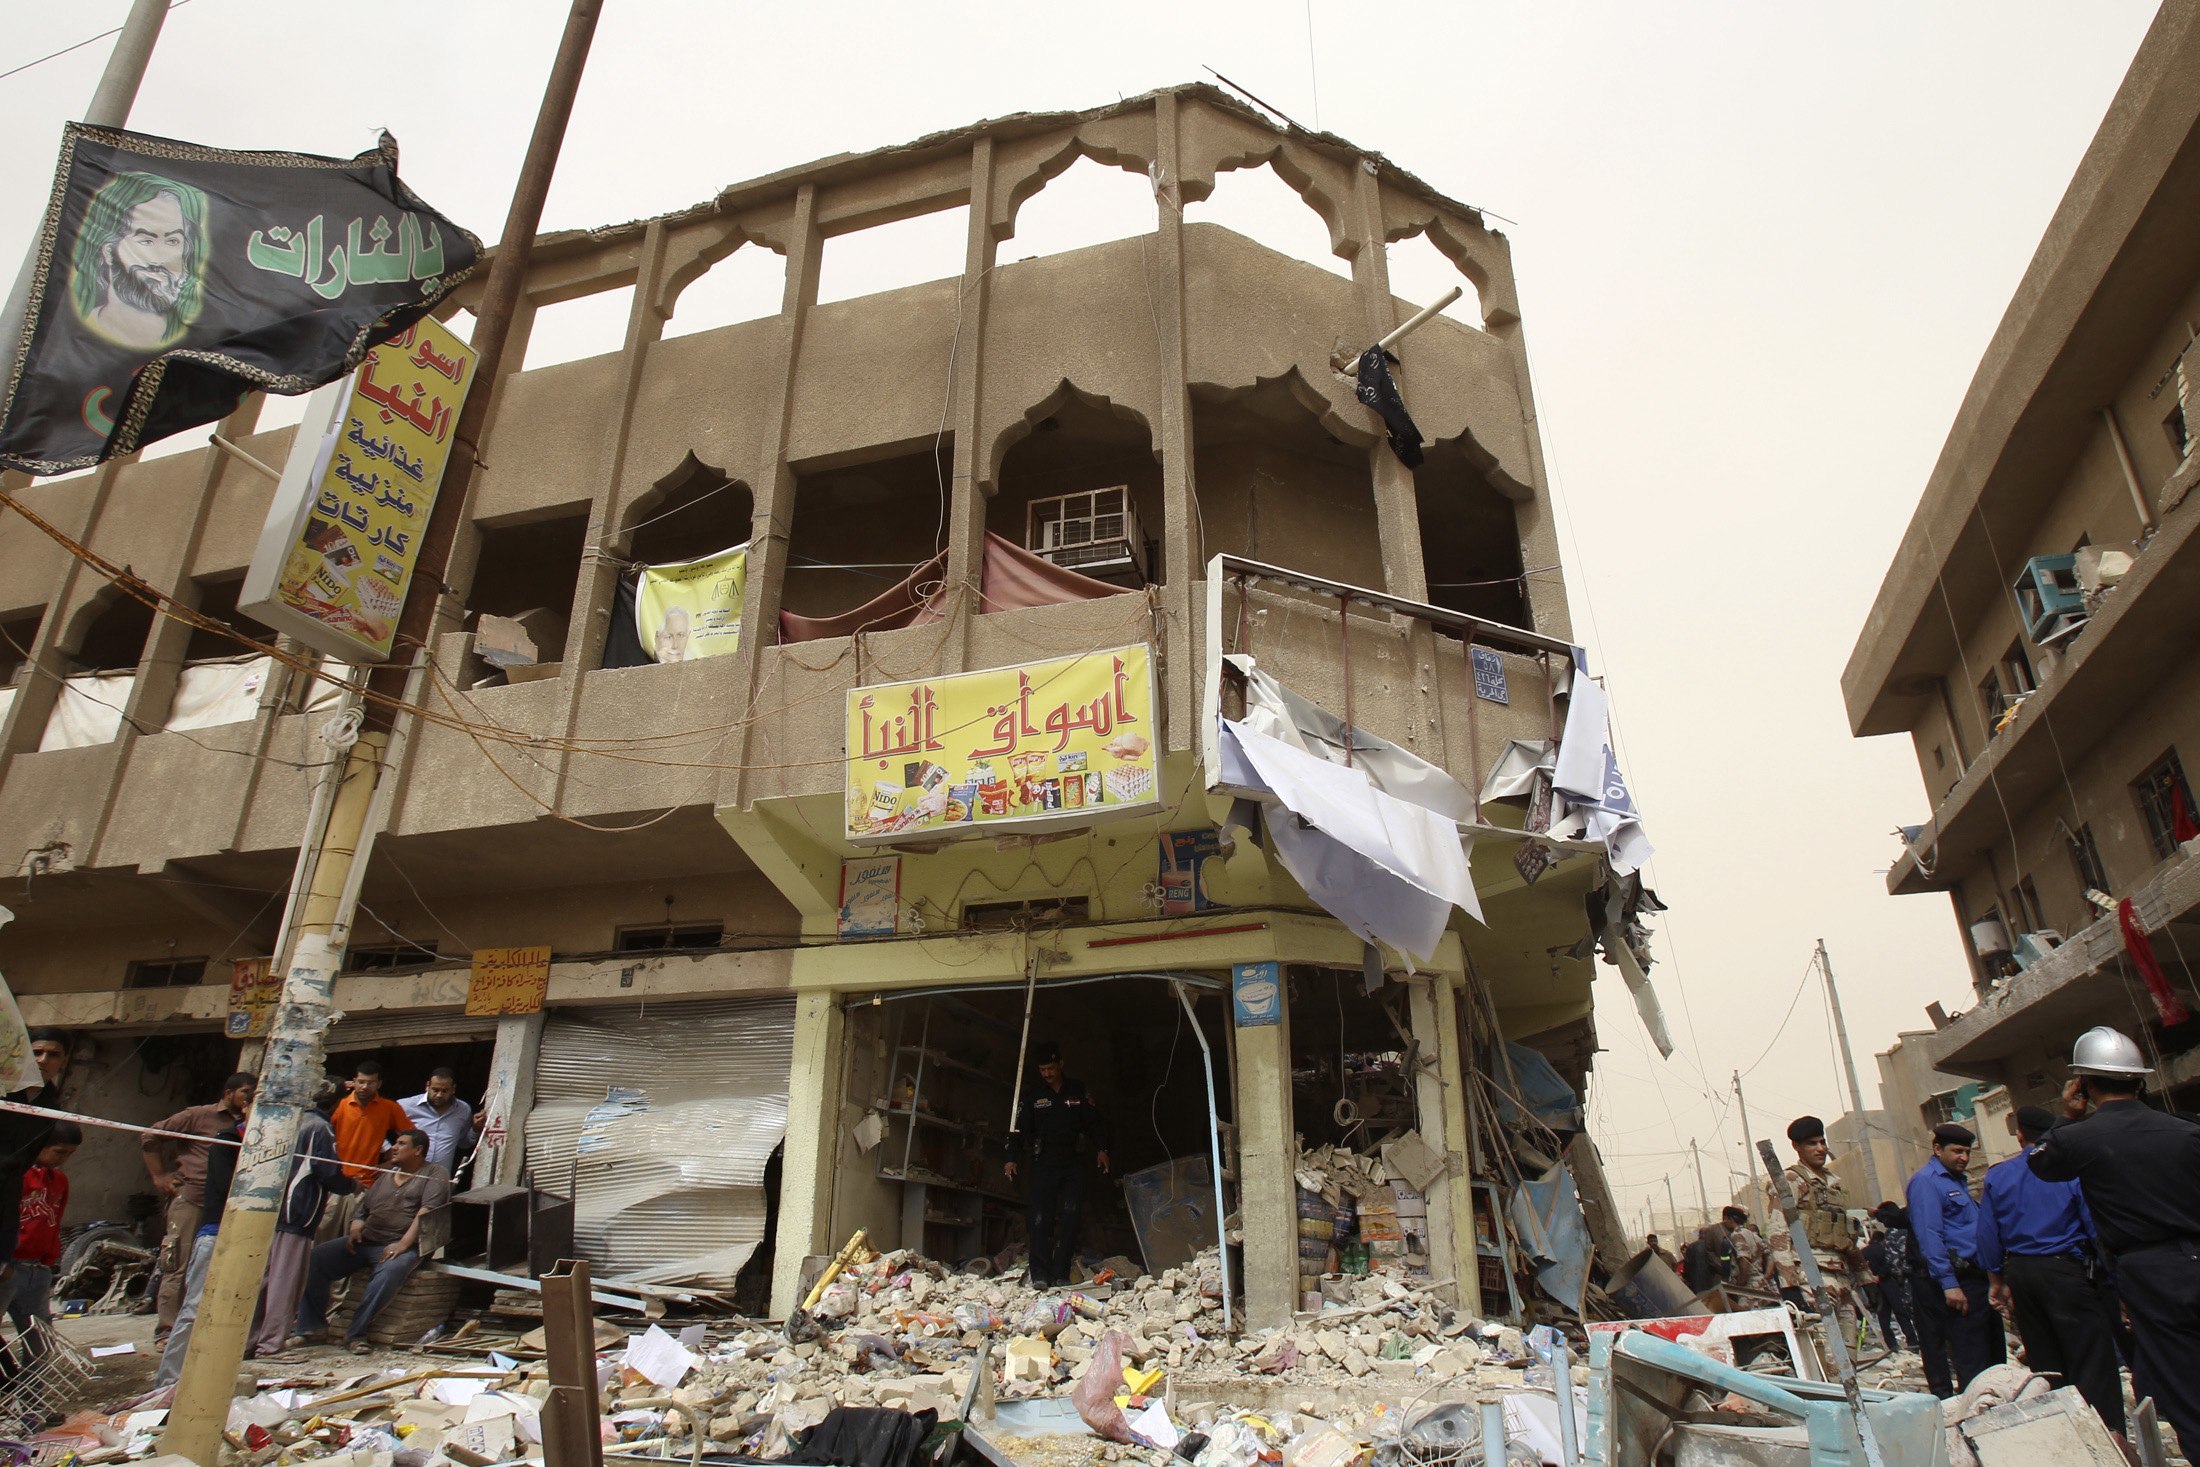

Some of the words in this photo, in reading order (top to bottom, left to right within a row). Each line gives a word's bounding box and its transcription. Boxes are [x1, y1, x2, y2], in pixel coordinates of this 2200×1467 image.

[348, 417, 425, 481] غذائية
[334, 453, 414, 516] منزلية
[316, 567, 342, 595] NIDO
[1479, 651, 1496, 663] زقاق
[872, 790, 897, 804] NIDO
[1168, 889, 1190, 899] RENG
